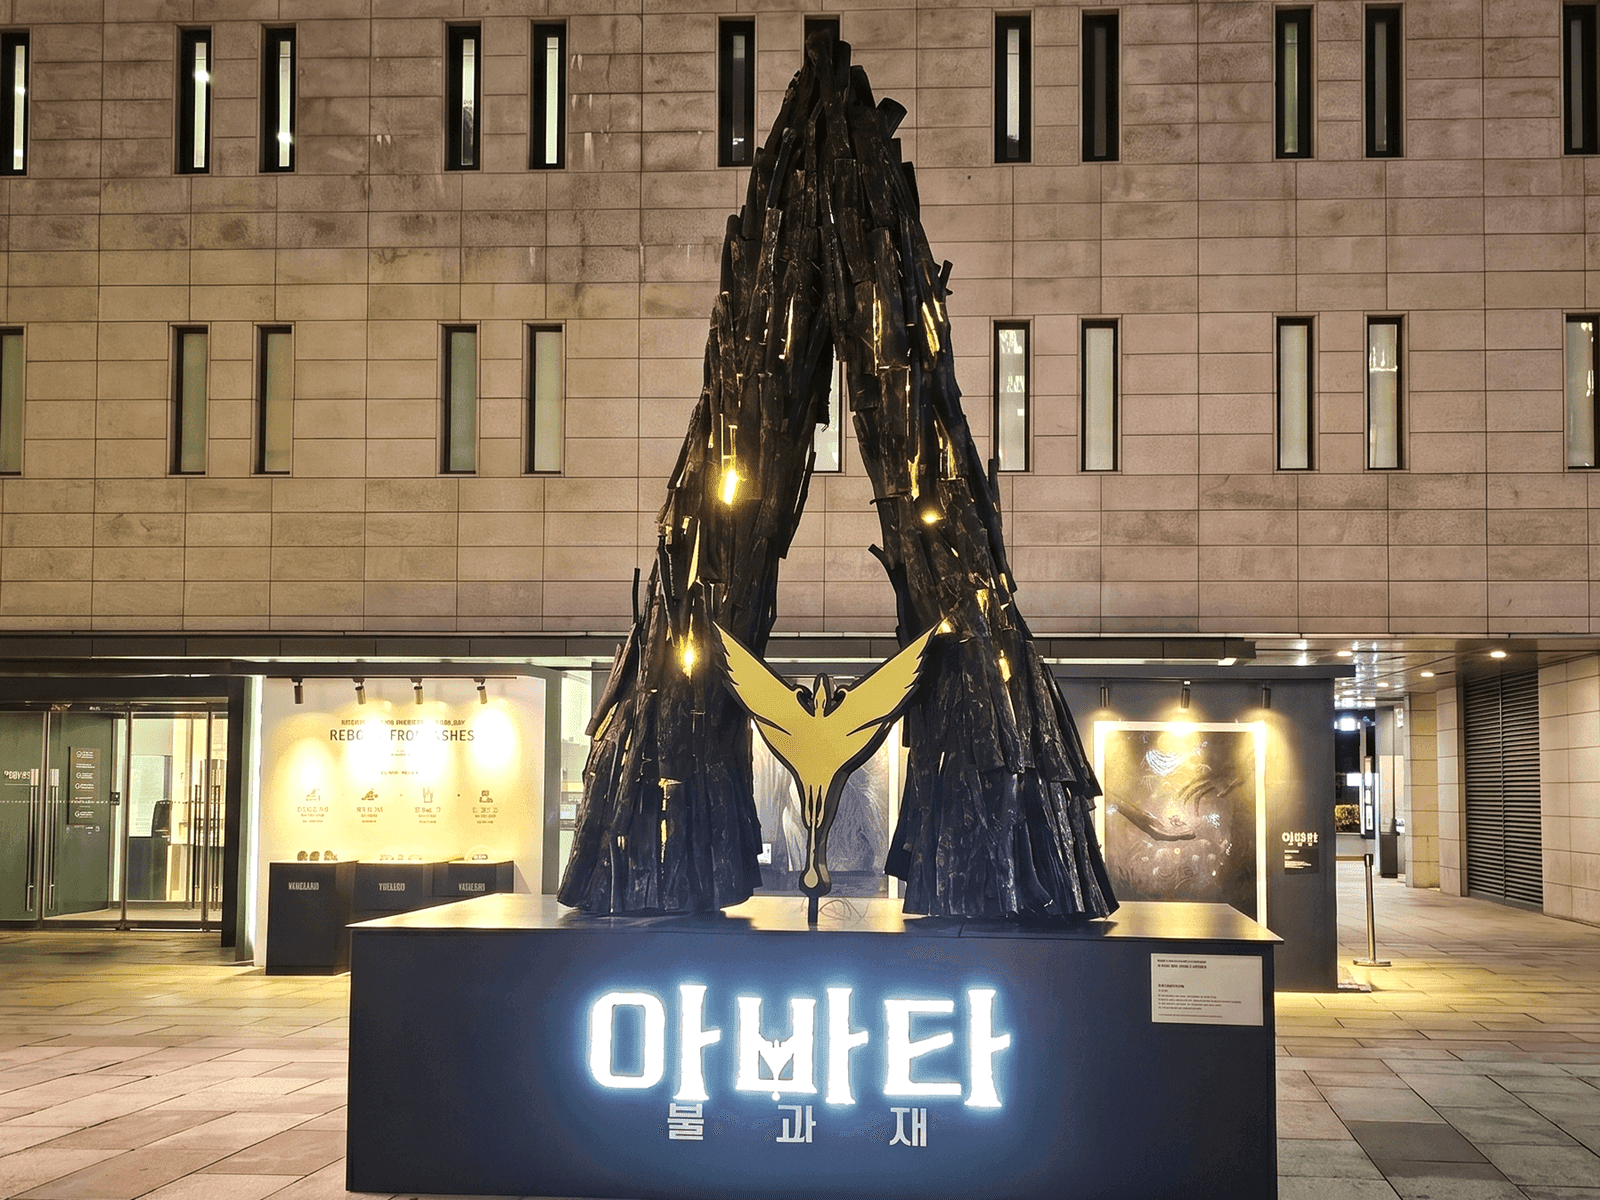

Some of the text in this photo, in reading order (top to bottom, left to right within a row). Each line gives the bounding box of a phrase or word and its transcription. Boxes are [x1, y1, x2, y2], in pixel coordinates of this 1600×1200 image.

[329, 729, 376, 742] REBO
[390, 729, 422, 742] FRO
[589, 983, 1011, 1108] 아바타
[667, 1102, 928, 1147] 불 과 재
